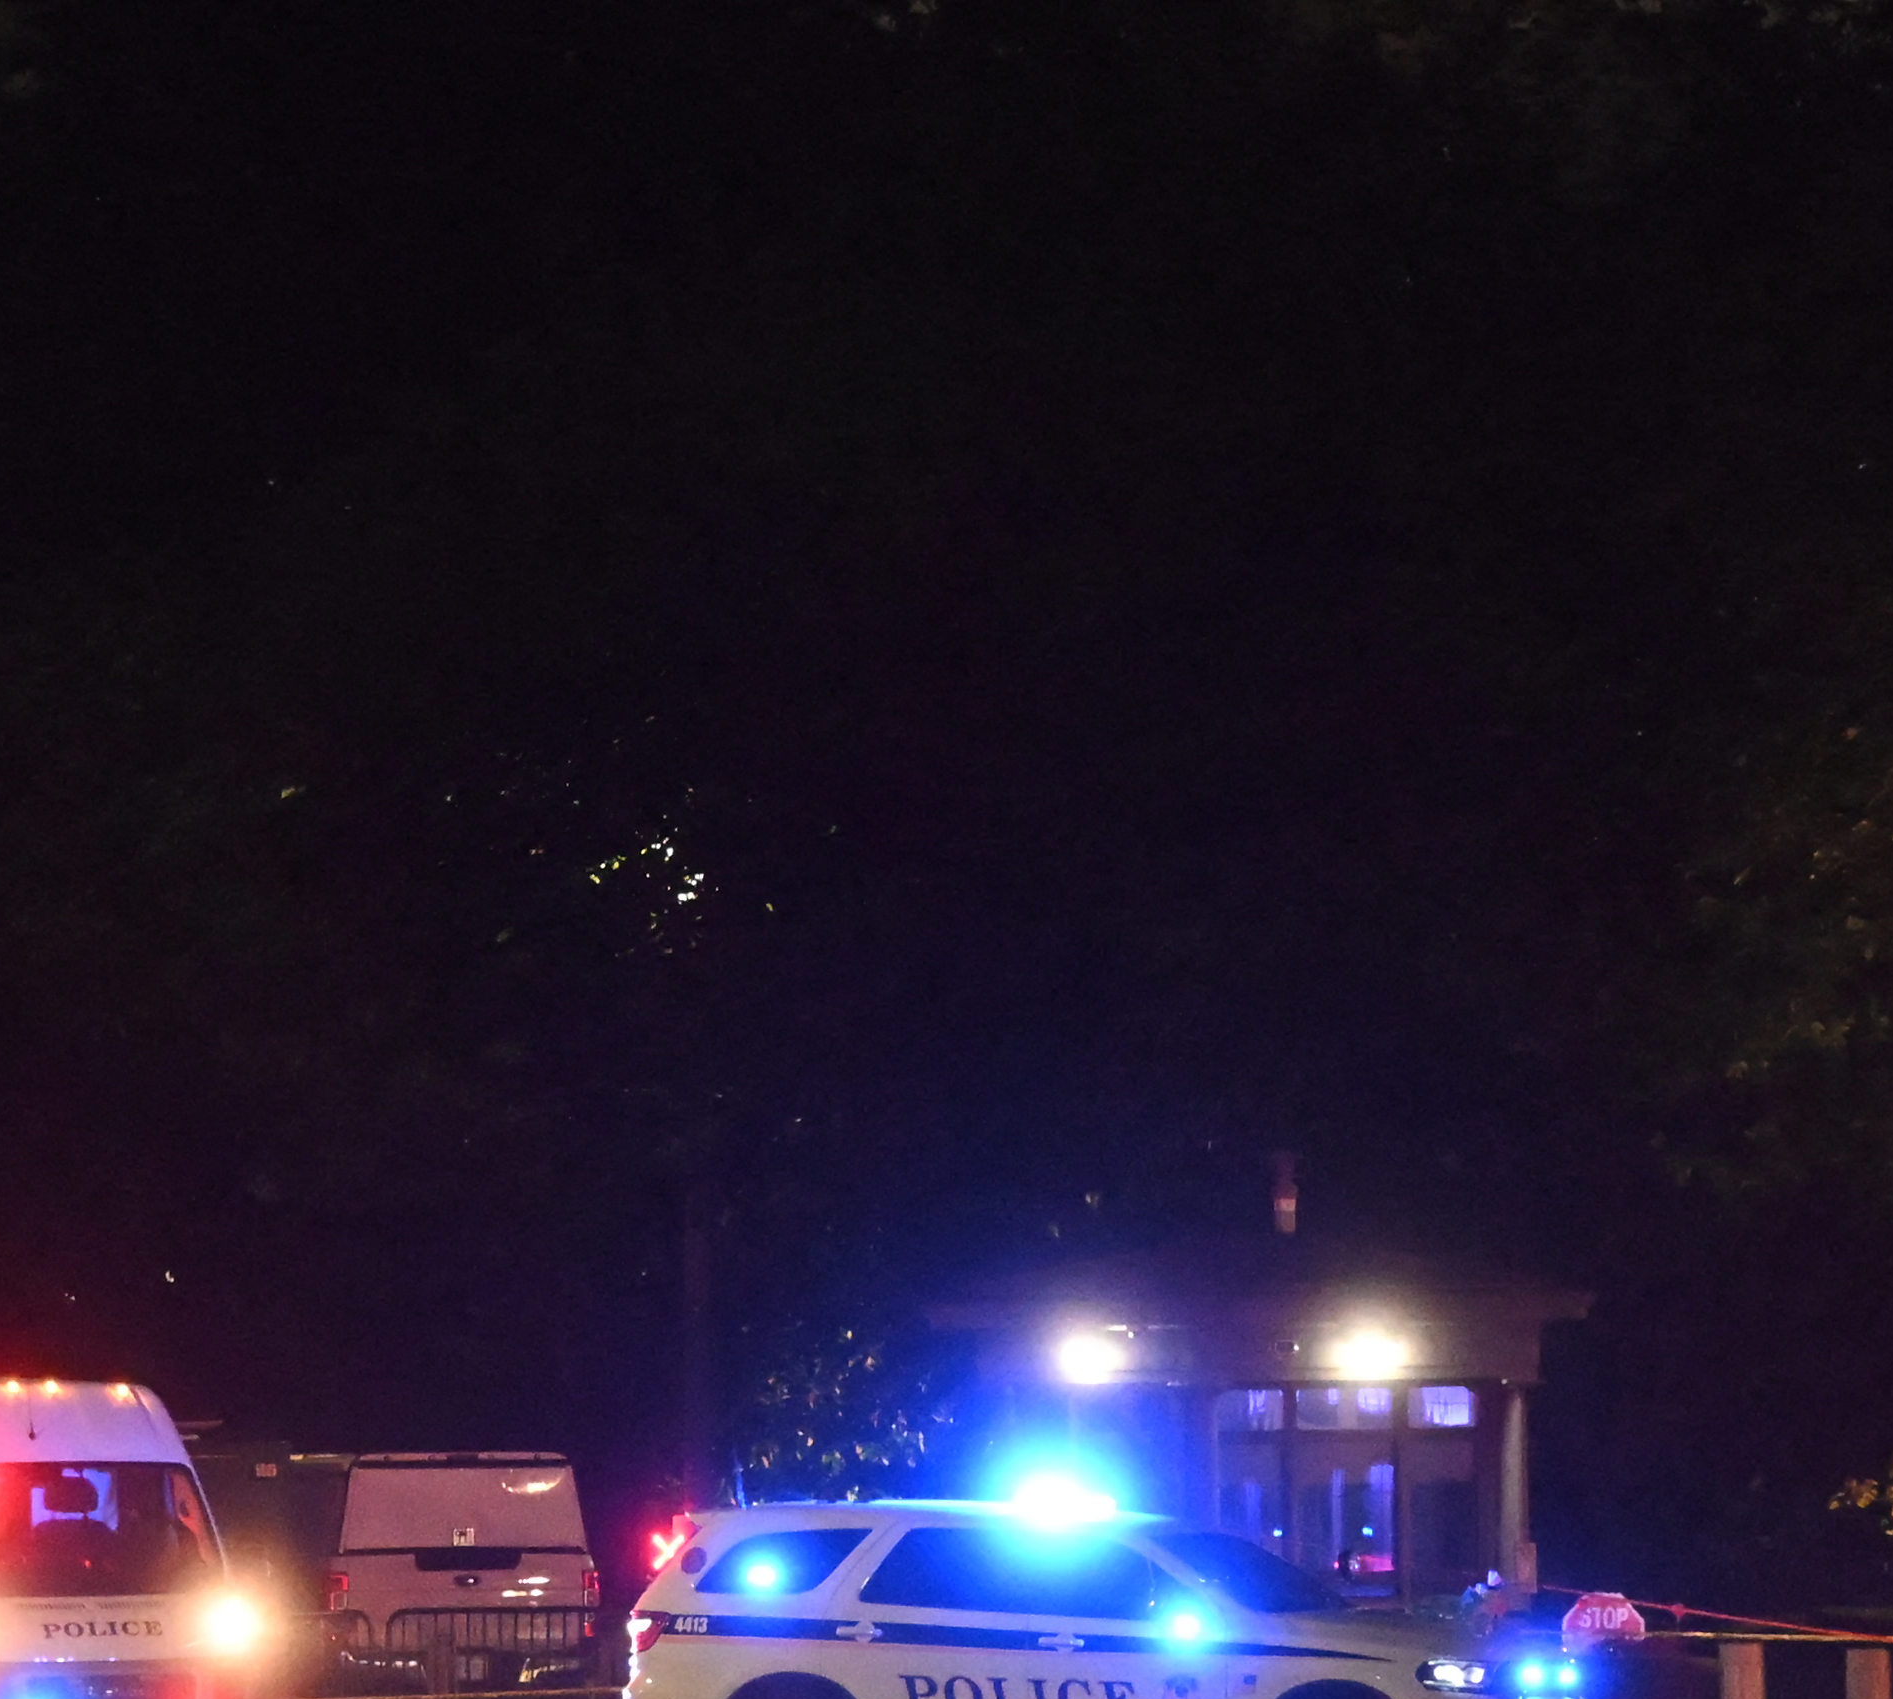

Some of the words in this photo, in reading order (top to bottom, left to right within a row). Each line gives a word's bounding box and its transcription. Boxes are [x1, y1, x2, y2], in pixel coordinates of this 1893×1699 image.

[674, 1616, 708, 1634] 4413
[1578, 1606, 1629, 1629] STOP
[43, 1620, 164, 1640] POLICE
